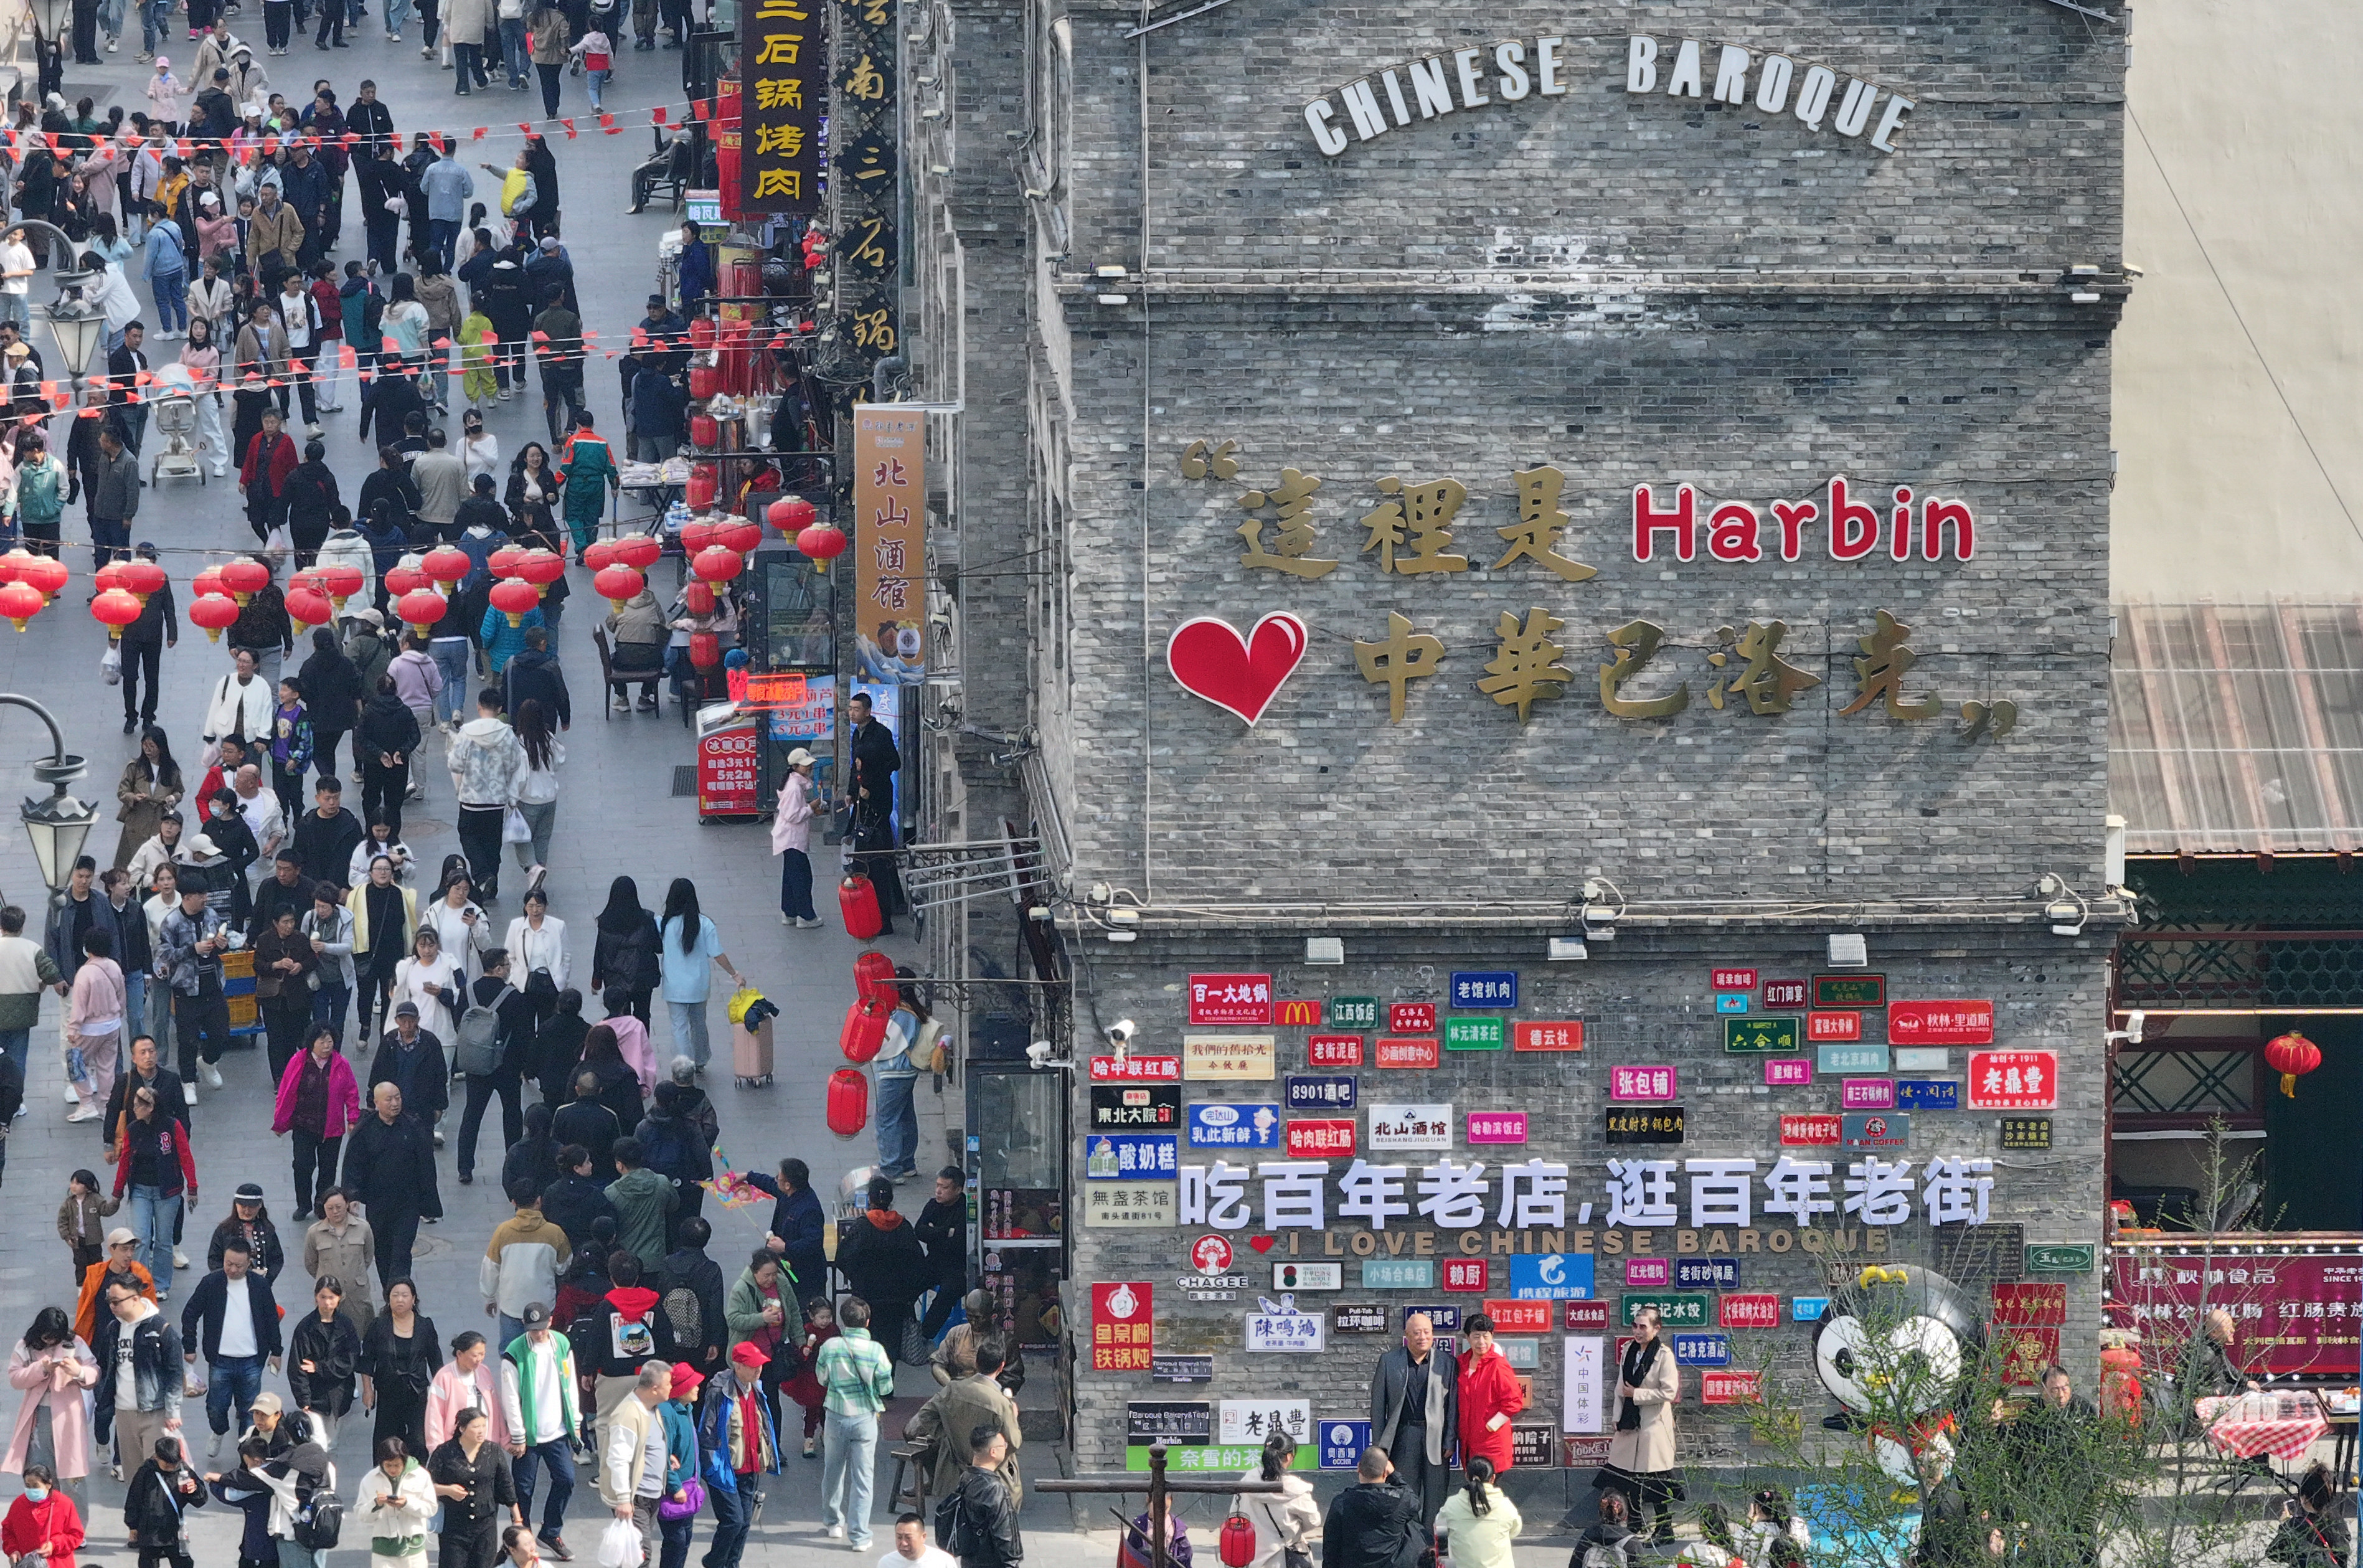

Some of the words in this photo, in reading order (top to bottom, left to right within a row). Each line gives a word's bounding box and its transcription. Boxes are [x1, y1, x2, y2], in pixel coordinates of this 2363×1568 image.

[1303, 34, 1567, 158] CHINESE
[1626, 34, 1918, 154] BAROQUE
[1631, 475, 1976, 565] Harbin
[872, 456, 909, 611] 北山酒馆
[1193, 983, 1268, 1003] 百一大地锅
[1458, 982, 1511, 998] 老馆扒肉
[1335, 1004, 1375, 1021] 江西饭店
[1450, 1025, 1499, 1041] 林元清茶庄
[1529, 1029, 1569, 1046] 德云社
[1314, 1042, 1357, 1059] 老街泥匠
[1381, 1046, 1433, 1062] 沙画创意中心
[1093, 1060, 1176, 1075] 哈中联红肠
[1292, 1084, 1351, 1100] 8901酒吧
[1618, 1071, 1669, 1096] 张包铺
[1098, 1107, 1158, 1123] 東北大院
[1205, 1110, 1233, 1121] 完达山
[1192, 1127, 1250, 1143] 乳此新鲜
[1374, 1122, 1447, 1136] 北山酒馆
[1291, 1128, 1352, 1148] 哈肉联红肠
[1119, 1143, 1175, 1171] 酸奶糕
[1324, 1230, 1435, 1255] LOVE
[1458, 1230, 1653, 1255] CHINESE
[1677, 1229, 1887, 1254] BAROQUE
[1369, 1266, 1426, 1282] 小场合串店
[1450, 1265, 1481, 1285] 赖厨
[1680, 1265, 1734, 1282] 老街砂锅居
[1177, 1277, 1248, 1288] CHAGEE
[1518, 1287, 1586, 1298] 携程旅游
[1337, 1315, 1385, 1328] 拉环咖啡
[1095, 1323, 1149, 1344] 鱼窝棚
[1678, 1341, 1726, 1358] 巴洛克酒店
[1095, 1348, 1149, 1369] 铁锅炖
[1577, 1367, 1590, 1424] 中国体彩
[1181, 1449, 1262, 1467] 奈雪的茶
